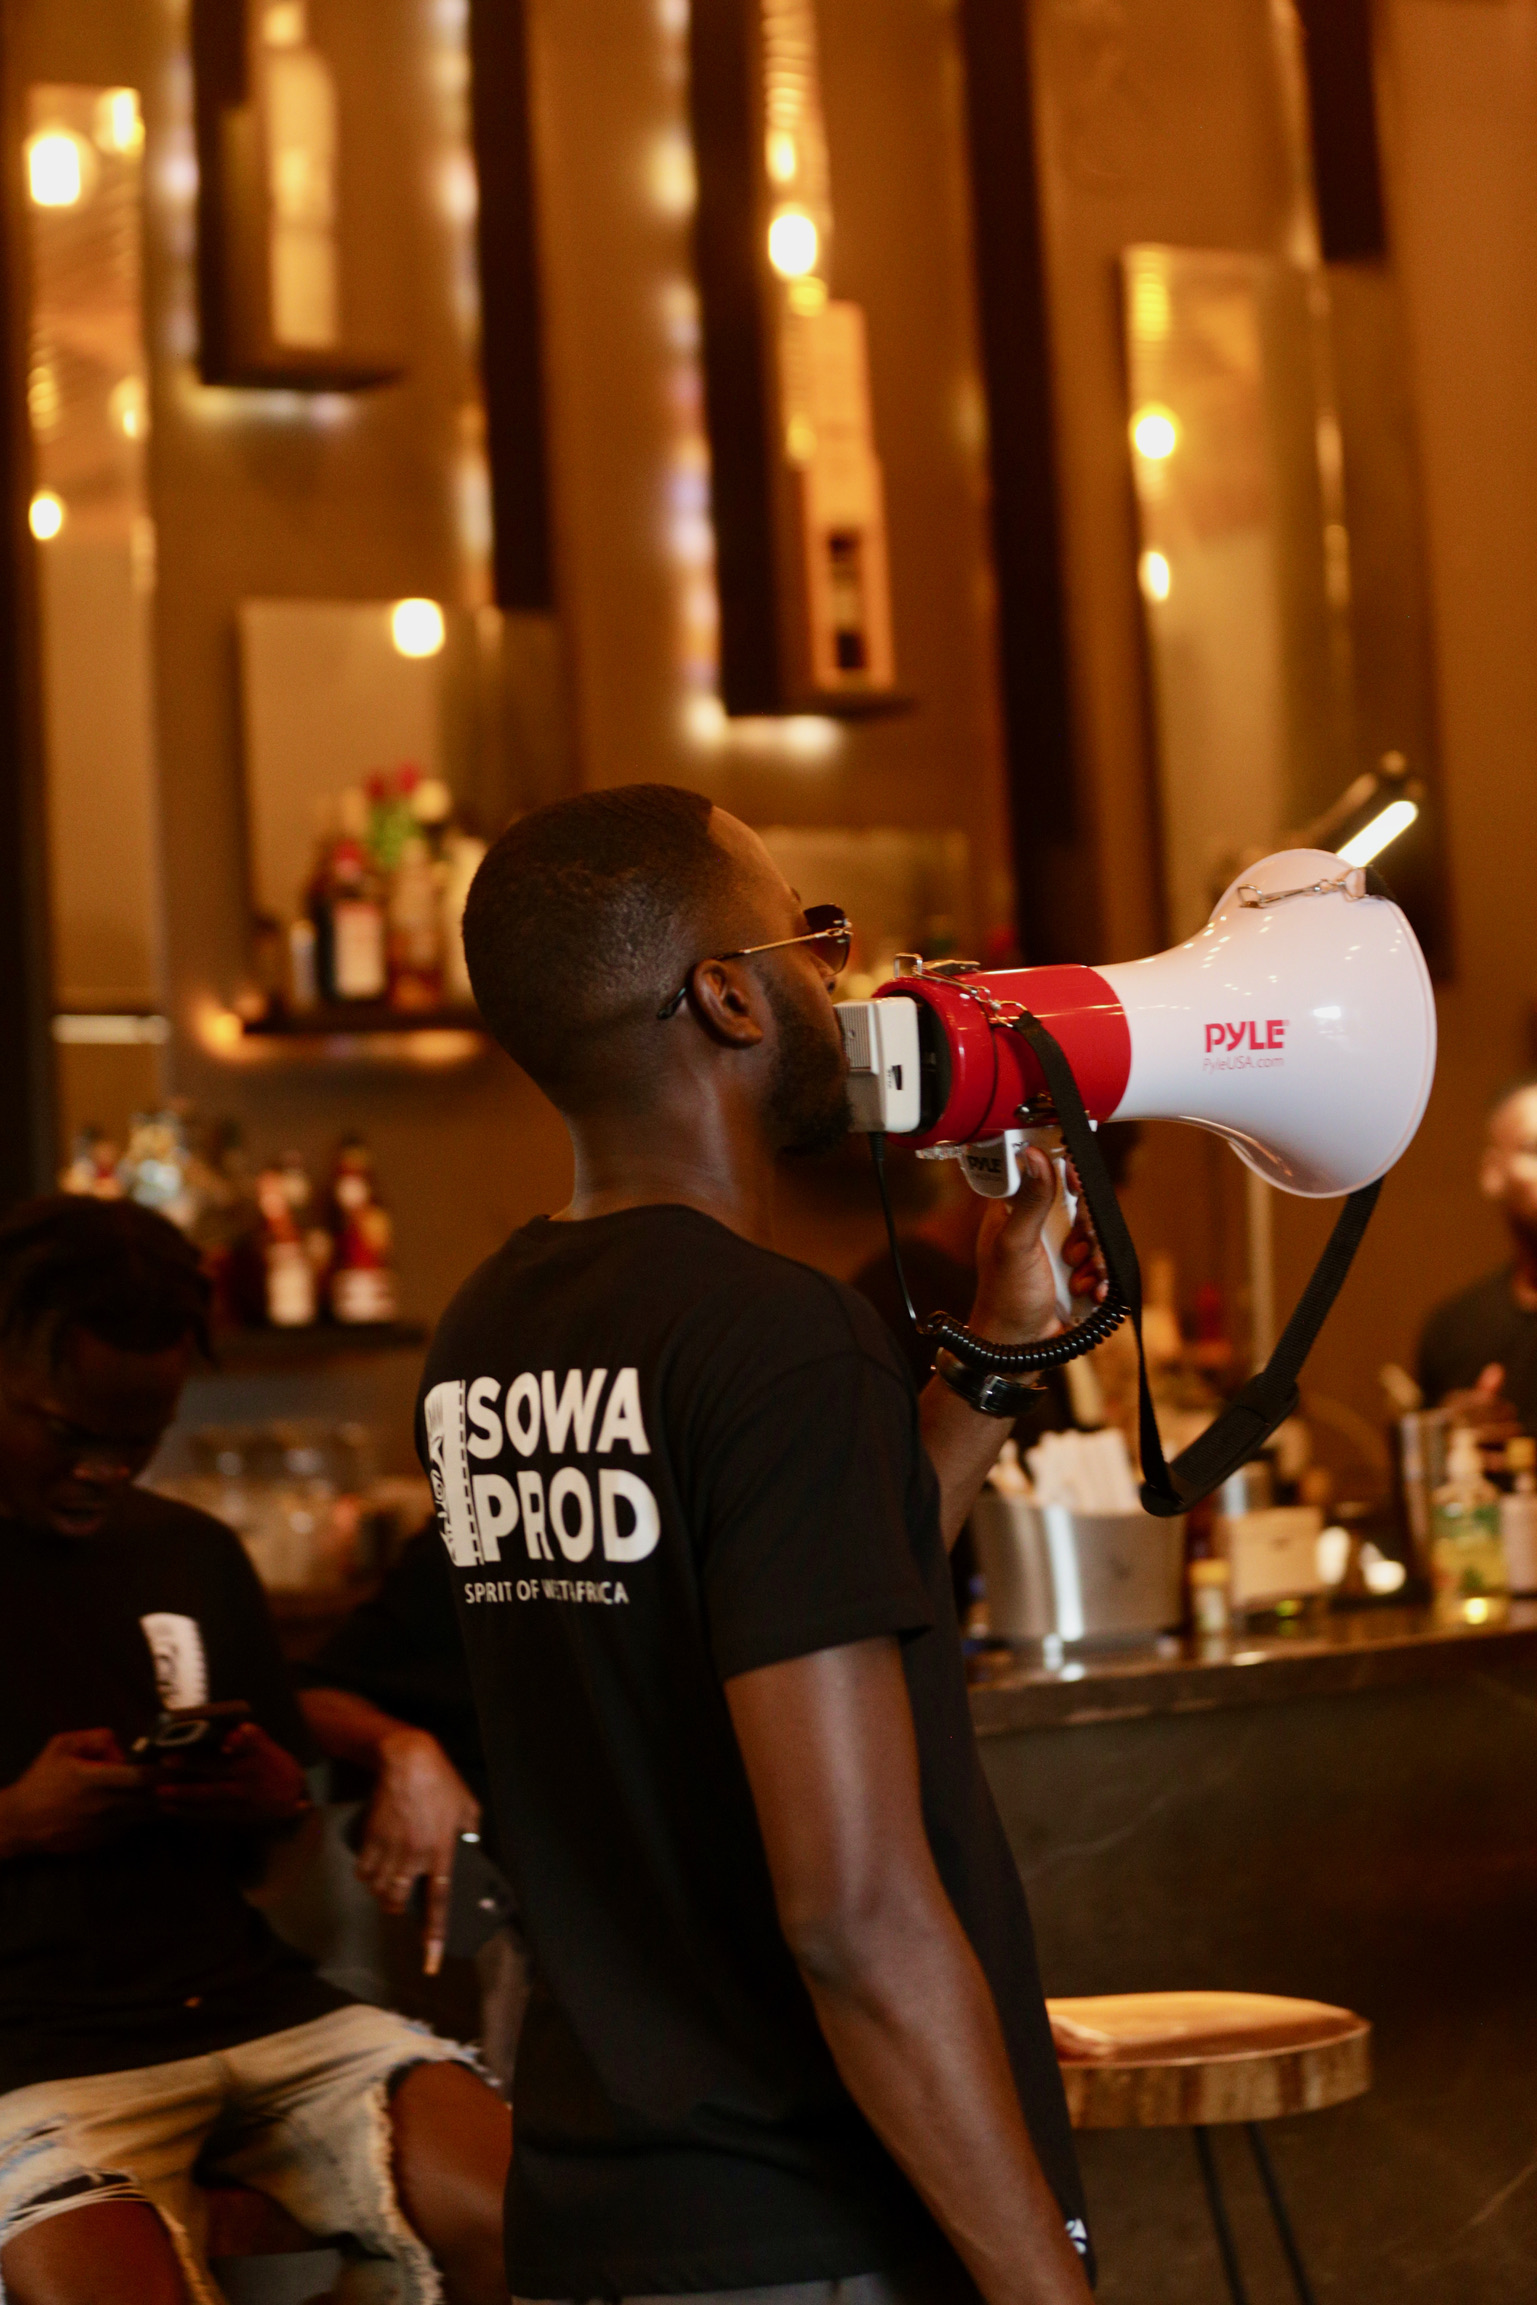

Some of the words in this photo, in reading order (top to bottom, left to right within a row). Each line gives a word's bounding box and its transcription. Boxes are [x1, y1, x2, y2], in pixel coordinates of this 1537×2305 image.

[1204, 1019, 1285, 1053] PYLE
[1202, 1055, 1285, 1075] PyleUSA.com
[966, 1155, 1001, 1172] PYLE
[466, 1367, 651, 1460] SOWA
[471, 1466, 661, 1563] PROD
[516, 1579, 540, 1601] OF
